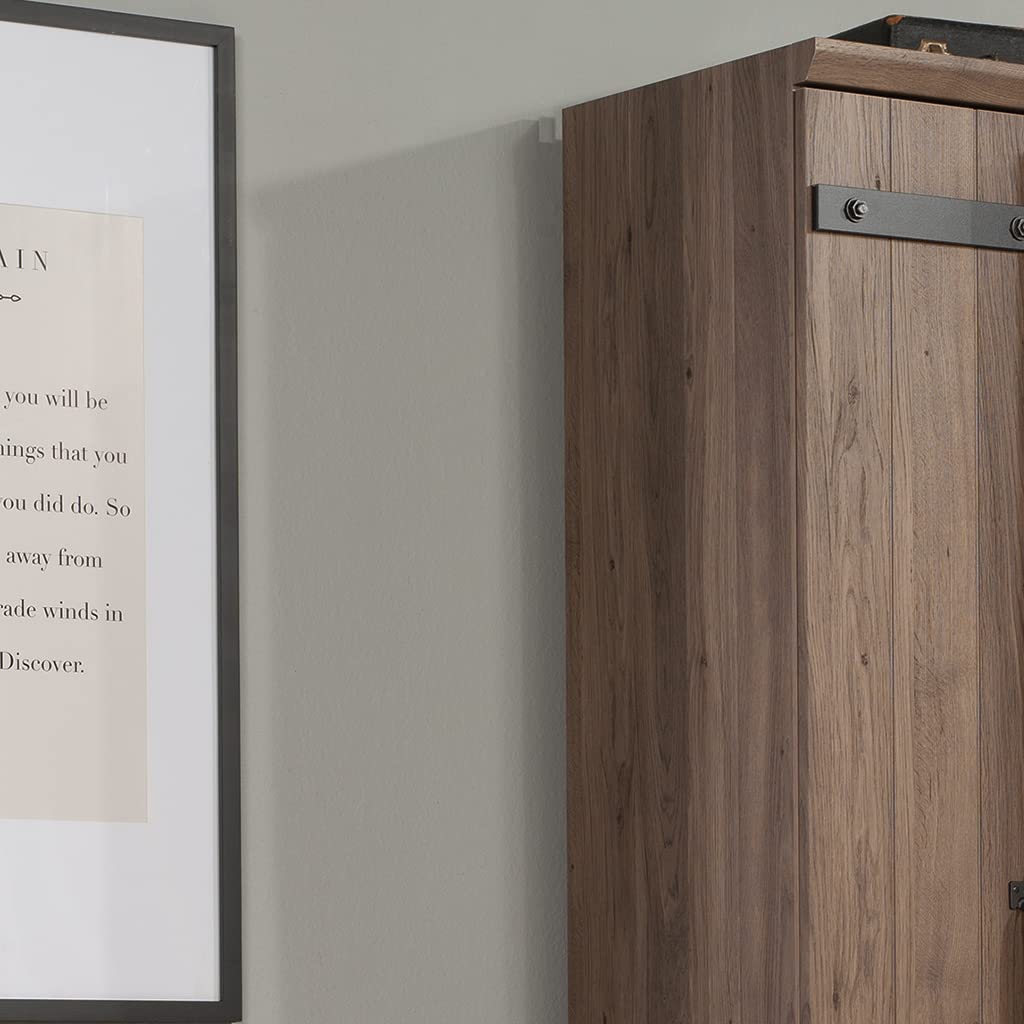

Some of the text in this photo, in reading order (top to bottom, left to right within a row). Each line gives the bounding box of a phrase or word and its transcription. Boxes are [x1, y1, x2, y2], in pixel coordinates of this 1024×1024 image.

[4, 389, 108, 410] you will be
[52, 441, 88, 461] that
[92, 450, 128, 469] you
[0, 493, 131, 517] ou did do. So
[6, 548, 103, 571] away from
[43, 601, 99, 621] winds
[105, 603, 123, 622] in
[0, 651, 84, 673] Discover.
